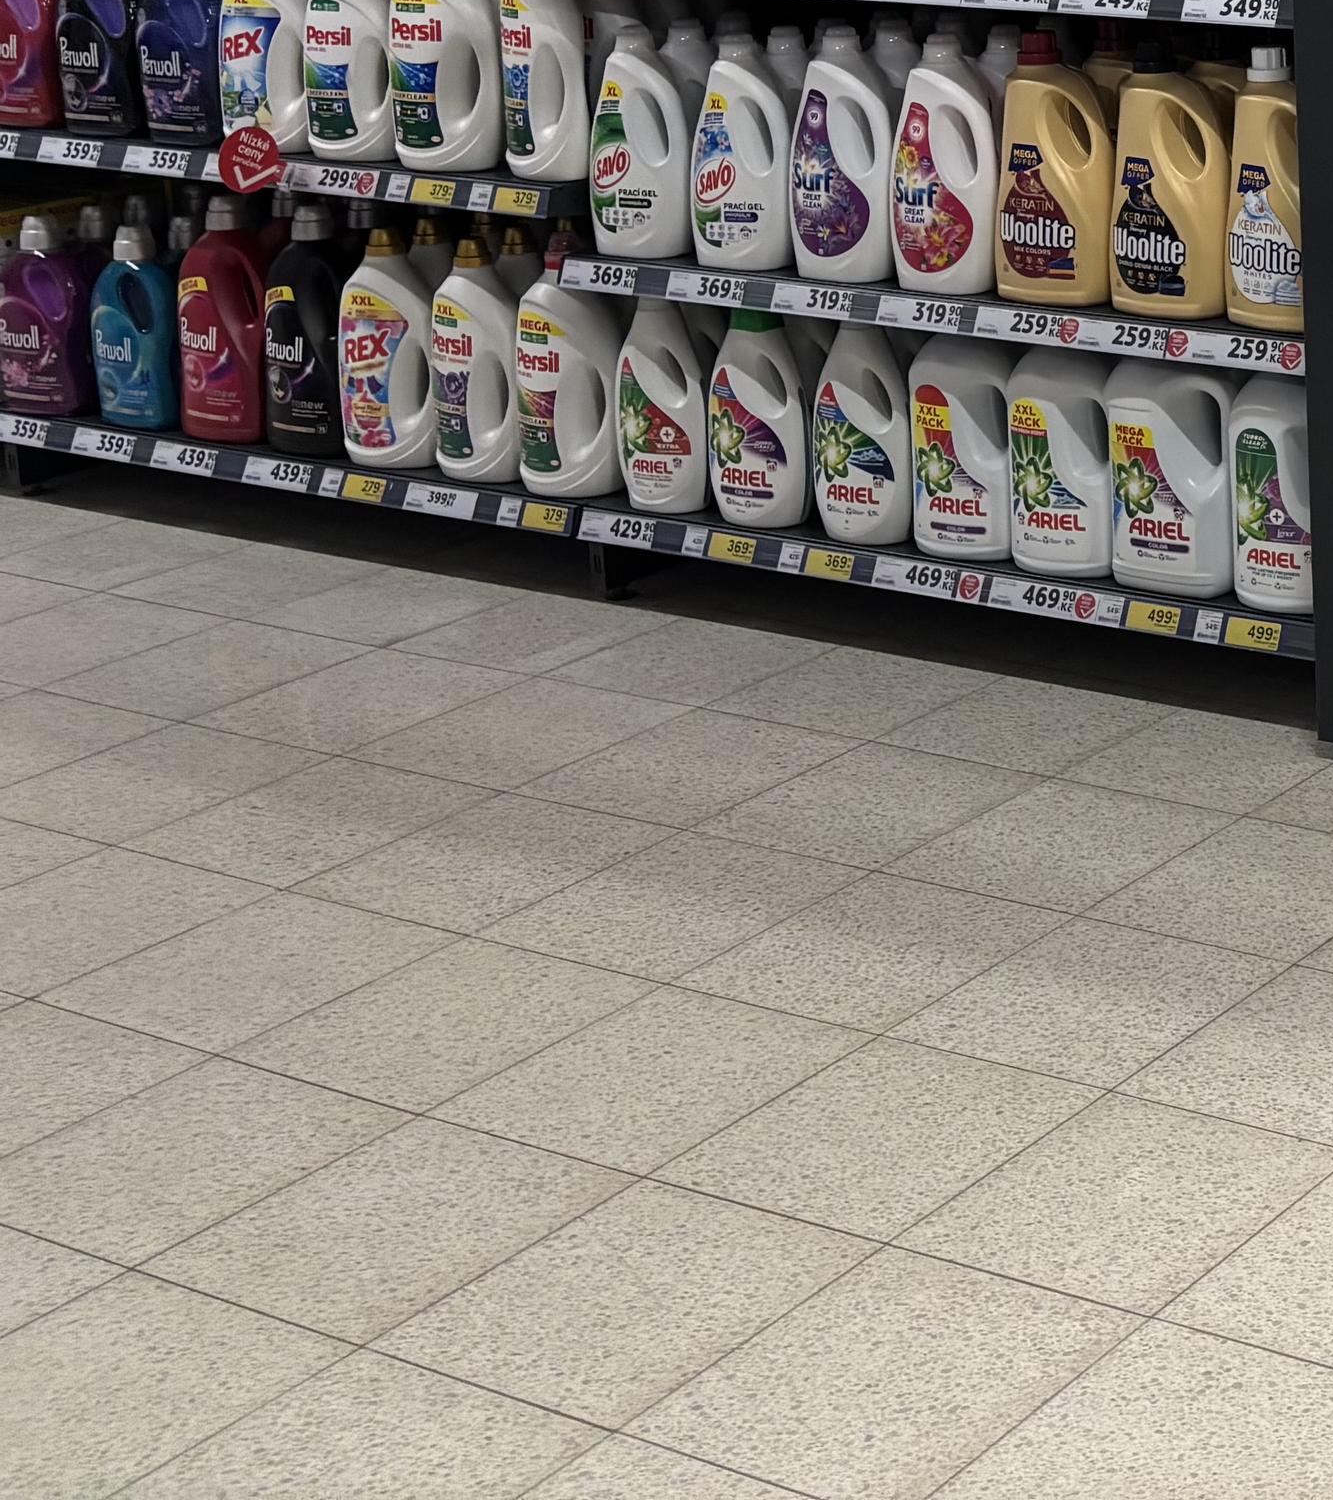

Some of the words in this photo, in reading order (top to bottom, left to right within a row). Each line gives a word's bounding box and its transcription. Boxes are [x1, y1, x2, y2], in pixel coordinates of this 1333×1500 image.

[306, 25, 352, 48] Persil
[391, 17, 442, 43] Persil
[59, 37, 99, 70] Perwoll
[223, 27, 264, 63] REX
[596, 151, 626, 181] SAVO
[1013, 149, 1037, 160] MEGA
[699, 163, 732, 194] SAVO
[793, 164, 834, 192] Surf
[618, 187, 639, 198] PRACÍ
[641, 190, 658, 198] GEL
[895, 178, 939, 208] Surf
[1009, 197, 1054, 212] KERATIN
[1001, 211, 1075, 250] Woolite
[1122, 211, 1165, 227] KERATIN
[1114, 224, 1185, 264] Woolite
[1229, 233, 1301, 275] Woolite
[95, 330, 132, 362] Perwoll
[180, 320, 216, 352] Perwoll
[344, 330, 388, 362] REX
[432, 332, 472, 357] Persil
[916, 415, 944, 428] PACK
[1012, 415, 1040, 428] PACK
[1115, 423, 1145, 437] MEGA
[632, 458, 673, 475] ARIEL
[721, 466, 773, 488] ARIEL
[827, 483, 880, 505] ARIEL
[929, 497, 987, 517] ARIEL
[1027, 511, 1086, 532] ARIEL
[1129, 517, 1190, 542] ARIEL
